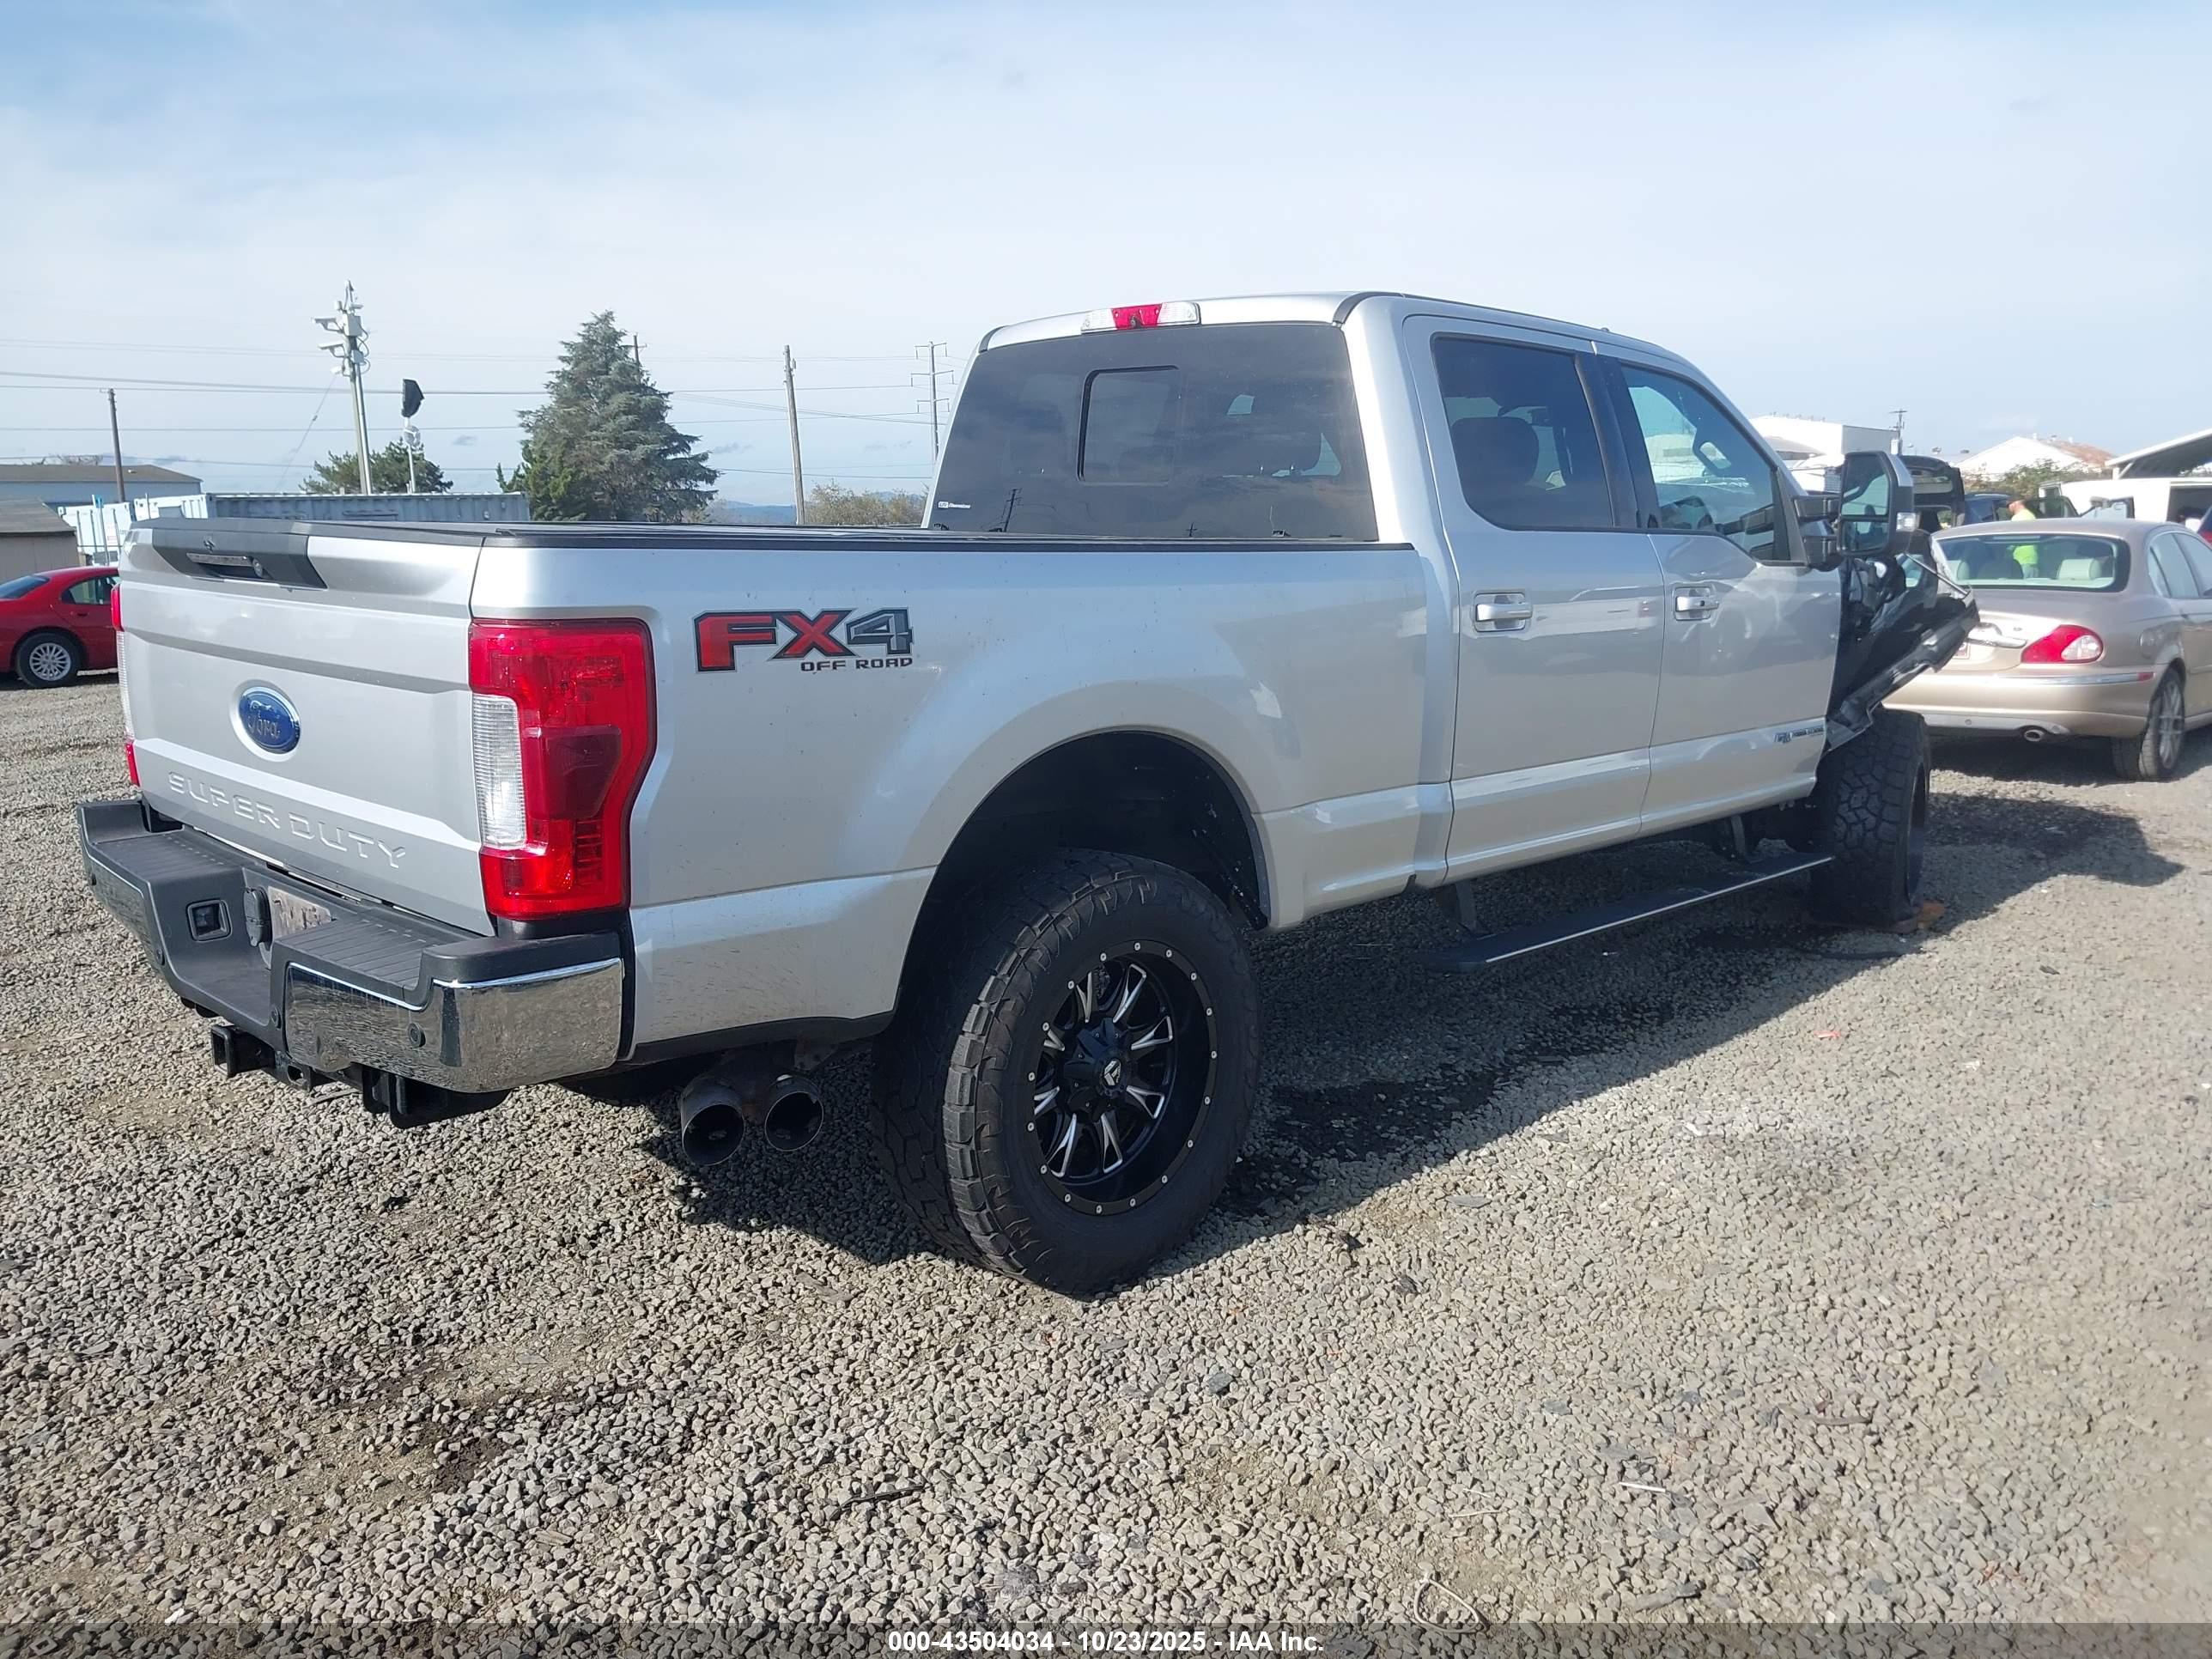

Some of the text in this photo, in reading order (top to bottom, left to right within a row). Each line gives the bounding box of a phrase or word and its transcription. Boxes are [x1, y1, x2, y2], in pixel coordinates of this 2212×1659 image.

[694, 608, 913, 672] FX4
[800, 658, 913, 672] OFF ROAD
[168, 771, 406, 869] SUPER DUTY
